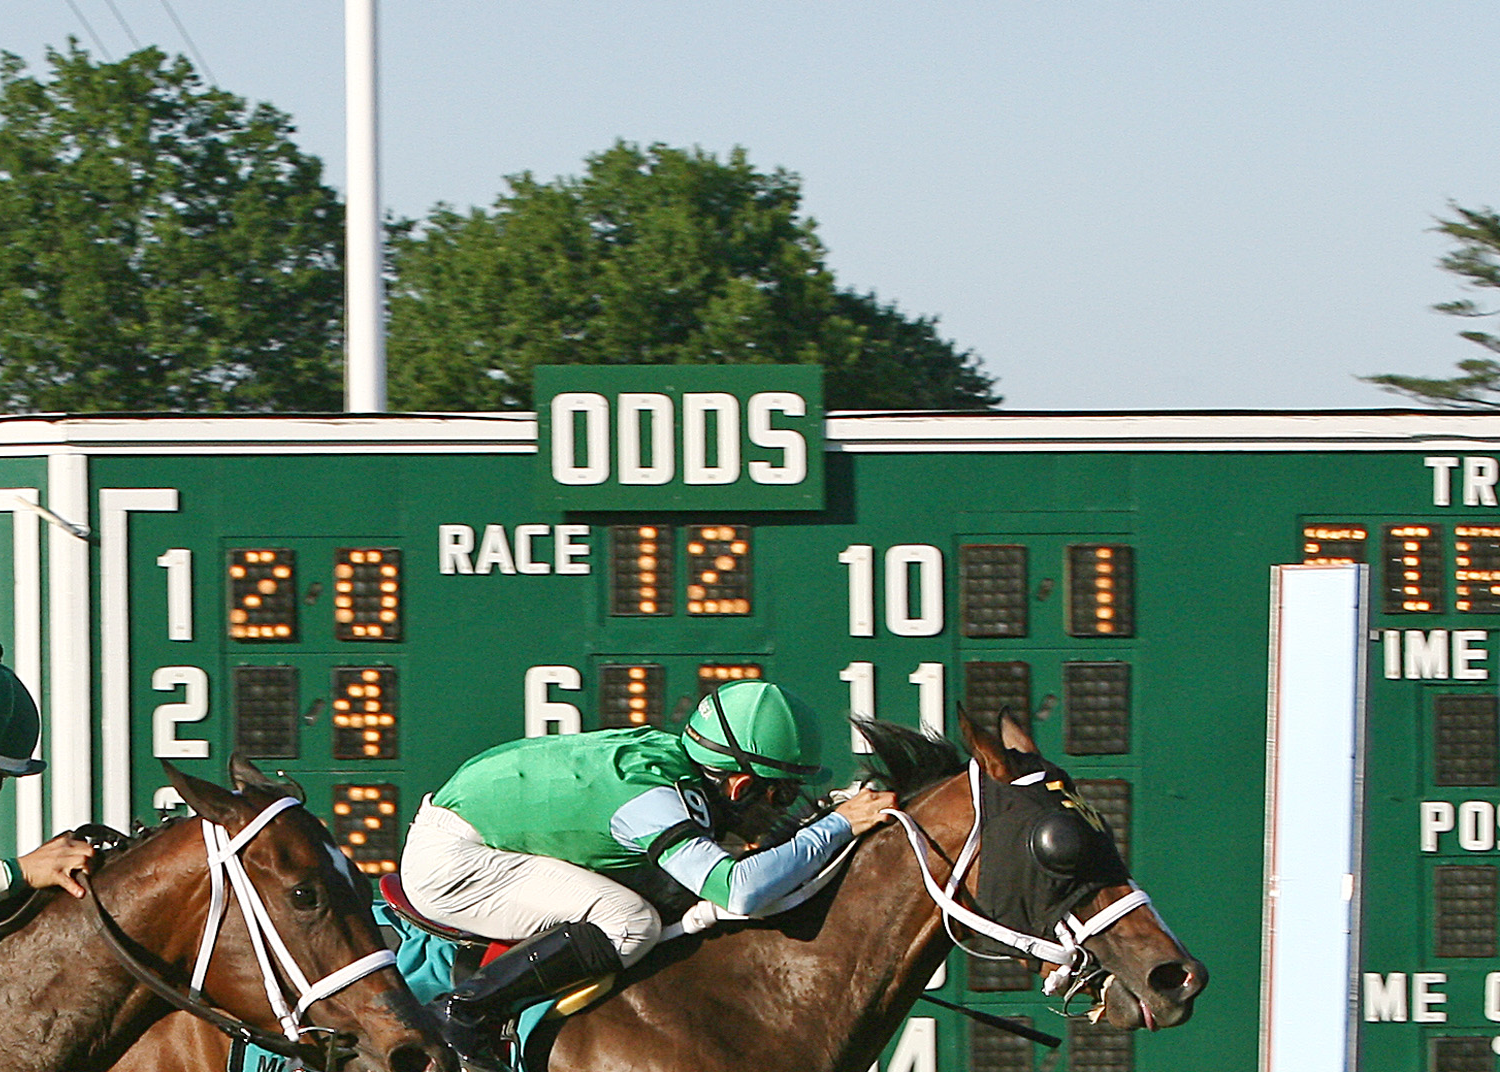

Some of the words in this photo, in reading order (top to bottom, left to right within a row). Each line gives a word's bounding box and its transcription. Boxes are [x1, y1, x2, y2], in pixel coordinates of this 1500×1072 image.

[552, 392, 806, 486] ODDS
[439, 524, 590, 575] RACE
[637, 526, 749, 614] 12
[839, 544, 943, 637] 10
[158, 549, 192, 641] 1
[1369, 629, 1489, 681] IME
[152, 666, 209, 758] 2
[333, 668, 396, 757] 4
[525, 666, 581, 736] 6
[839, 661, 944, 754] 11
[1421, 801, 1500, 852] PO
[1364, 972, 1447, 1023] ME
